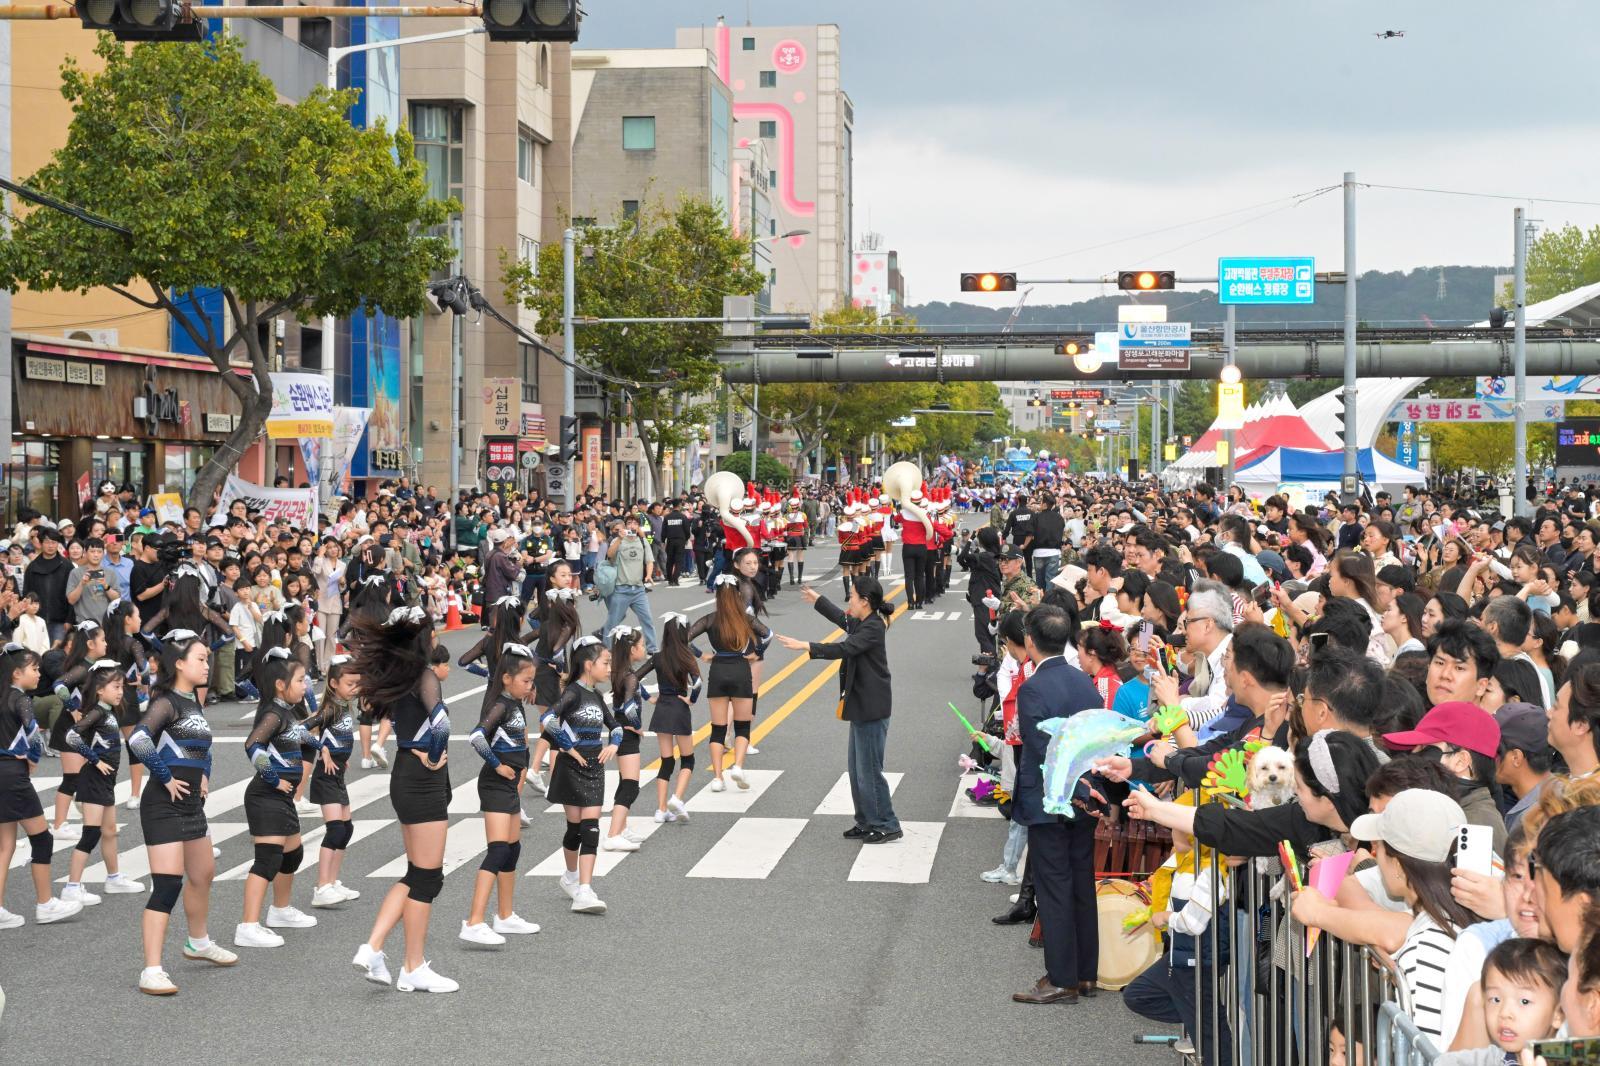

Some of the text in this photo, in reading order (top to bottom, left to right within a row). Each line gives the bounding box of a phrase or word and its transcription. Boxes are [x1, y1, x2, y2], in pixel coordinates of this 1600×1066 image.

[1229, 283, 1289, 296] 순환버스 정류장
[1140, 325, 1186, 333] 울산항만공사
[495, 386, 509, 431] 십원빵
[667, 519, 683, 527] SECURITY
